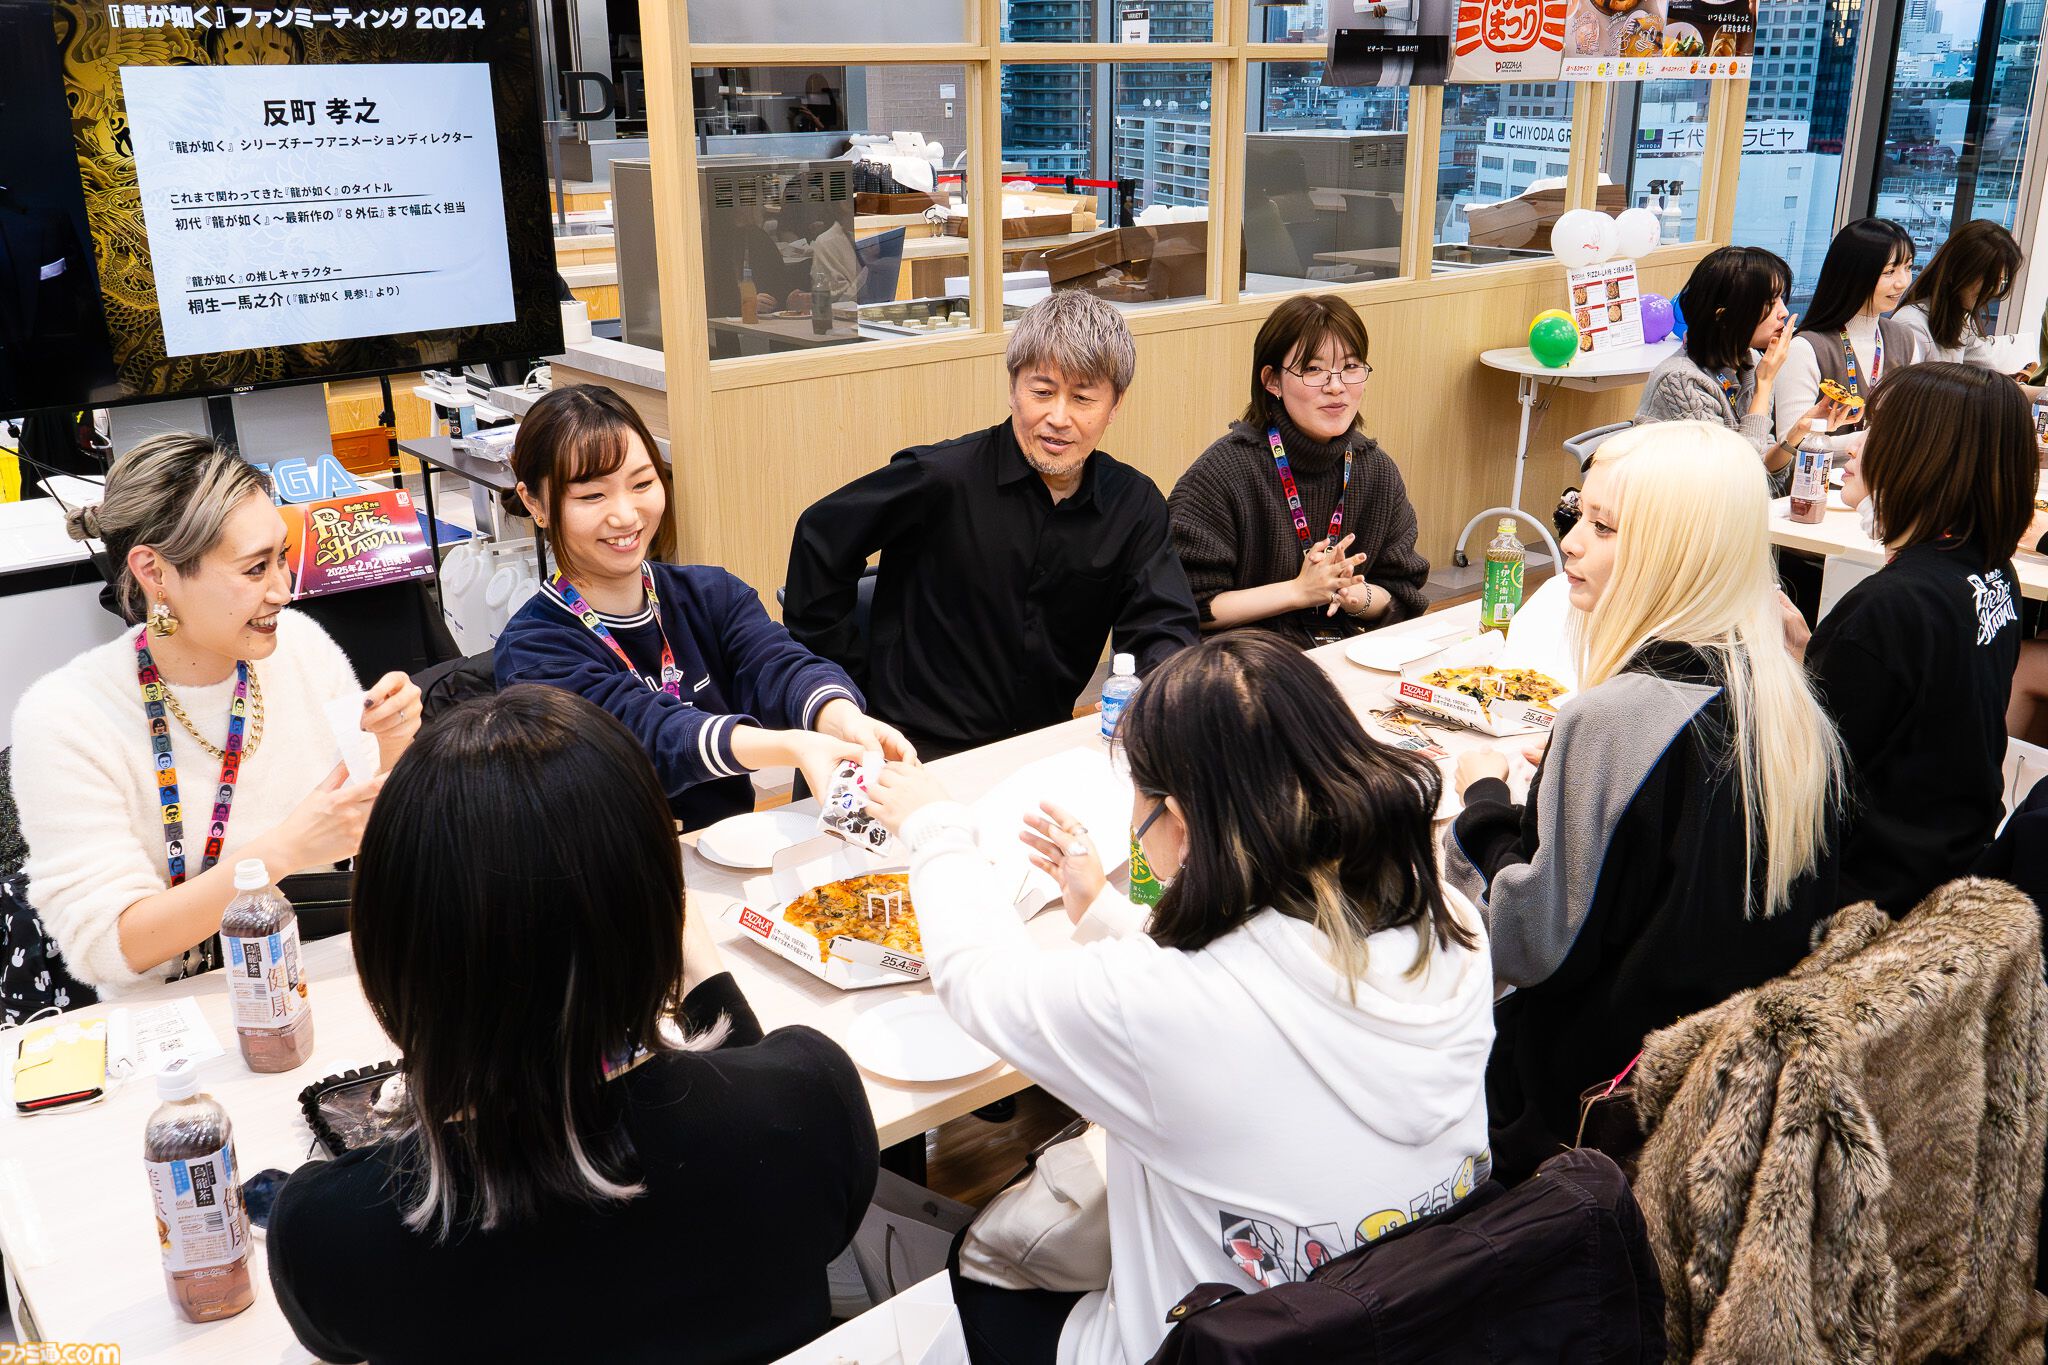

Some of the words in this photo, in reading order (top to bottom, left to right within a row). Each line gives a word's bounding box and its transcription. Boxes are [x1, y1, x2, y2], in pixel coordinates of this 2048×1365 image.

[415, 7, 486, 30] 2024
[1488, 8, 1538, 41] まつり
[1707, 13, 1749, 23] いつもよりちょっと
[264, 99, 316, 127] 反町
[325, 96, 380, 126] 孝之
[1509, 124, 1554, 142] CHIYODA
[170, 182, 393, 205] これまで関わってきた『龍が如く』のタイトル
[185, 266, 343, 289] 『龍が如く』の推しキャラクター
[233, 385, 254, 393] SONY
[311, 508, 391, 545] PIRATES
[326, 531, 407, 565] HAWAII
[325, 553, 412, 578] 2025年2月21日発売
[1403, 683, 1431, 698] PIZZA-LA
[1522, 711, 1551, 726] 25.4cm
[743, 909, 773, 932] PIZZA-LA
[246, 944, 260, 975] 烏龍茶
[881, 955, 920, 974] 25.4cm
[267, 966, 293, 1019] 健康
[193, 1166, 212, 1202] 烏龍茶
